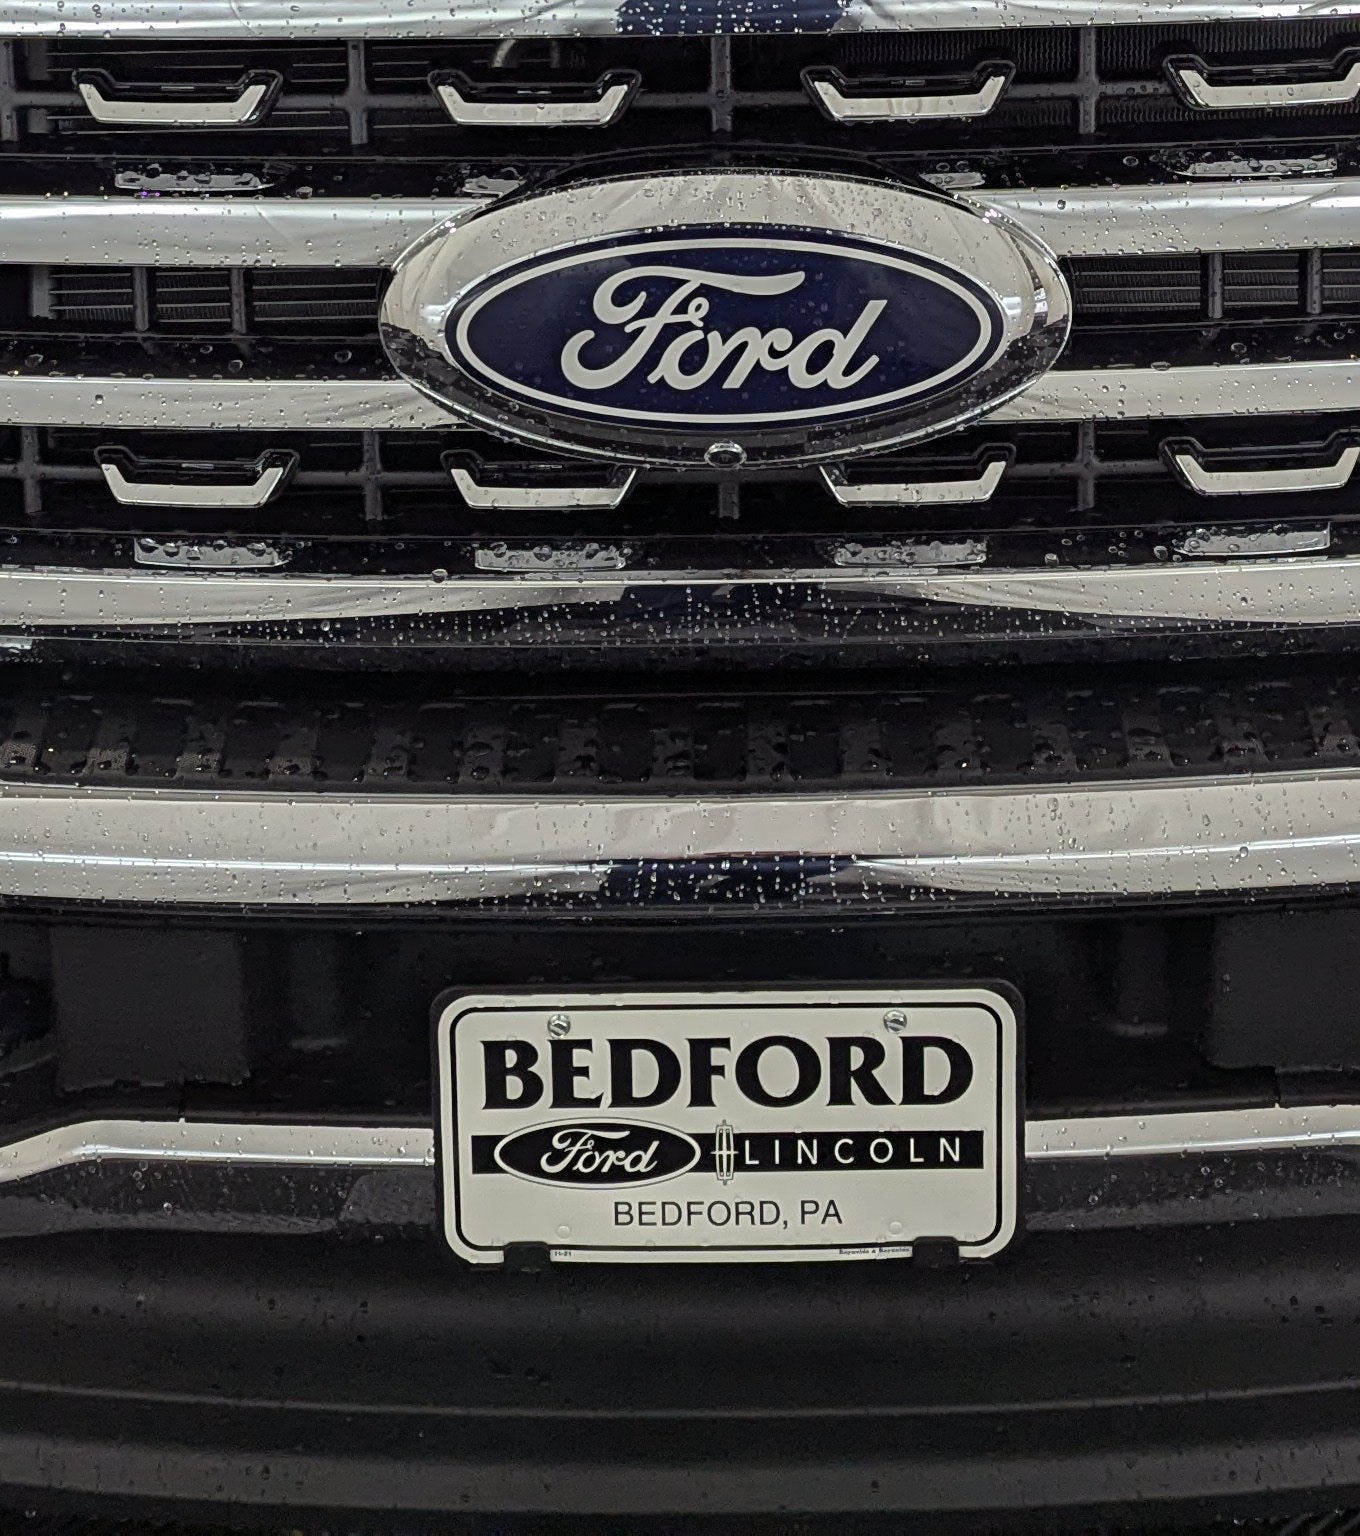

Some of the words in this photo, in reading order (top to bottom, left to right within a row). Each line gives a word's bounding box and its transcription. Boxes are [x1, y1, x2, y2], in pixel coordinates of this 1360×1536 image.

[560, 265, 889, 390] Ford
[480, 1035, 974, 1110] BEDFORD
[540, 1128, 661, 1174] Ford
[744, 1137, 961, 1166] LINCOLN
[613, 1199, 789, 1230] BEDFORD,
[799, 1199, 843, 1226] PA
